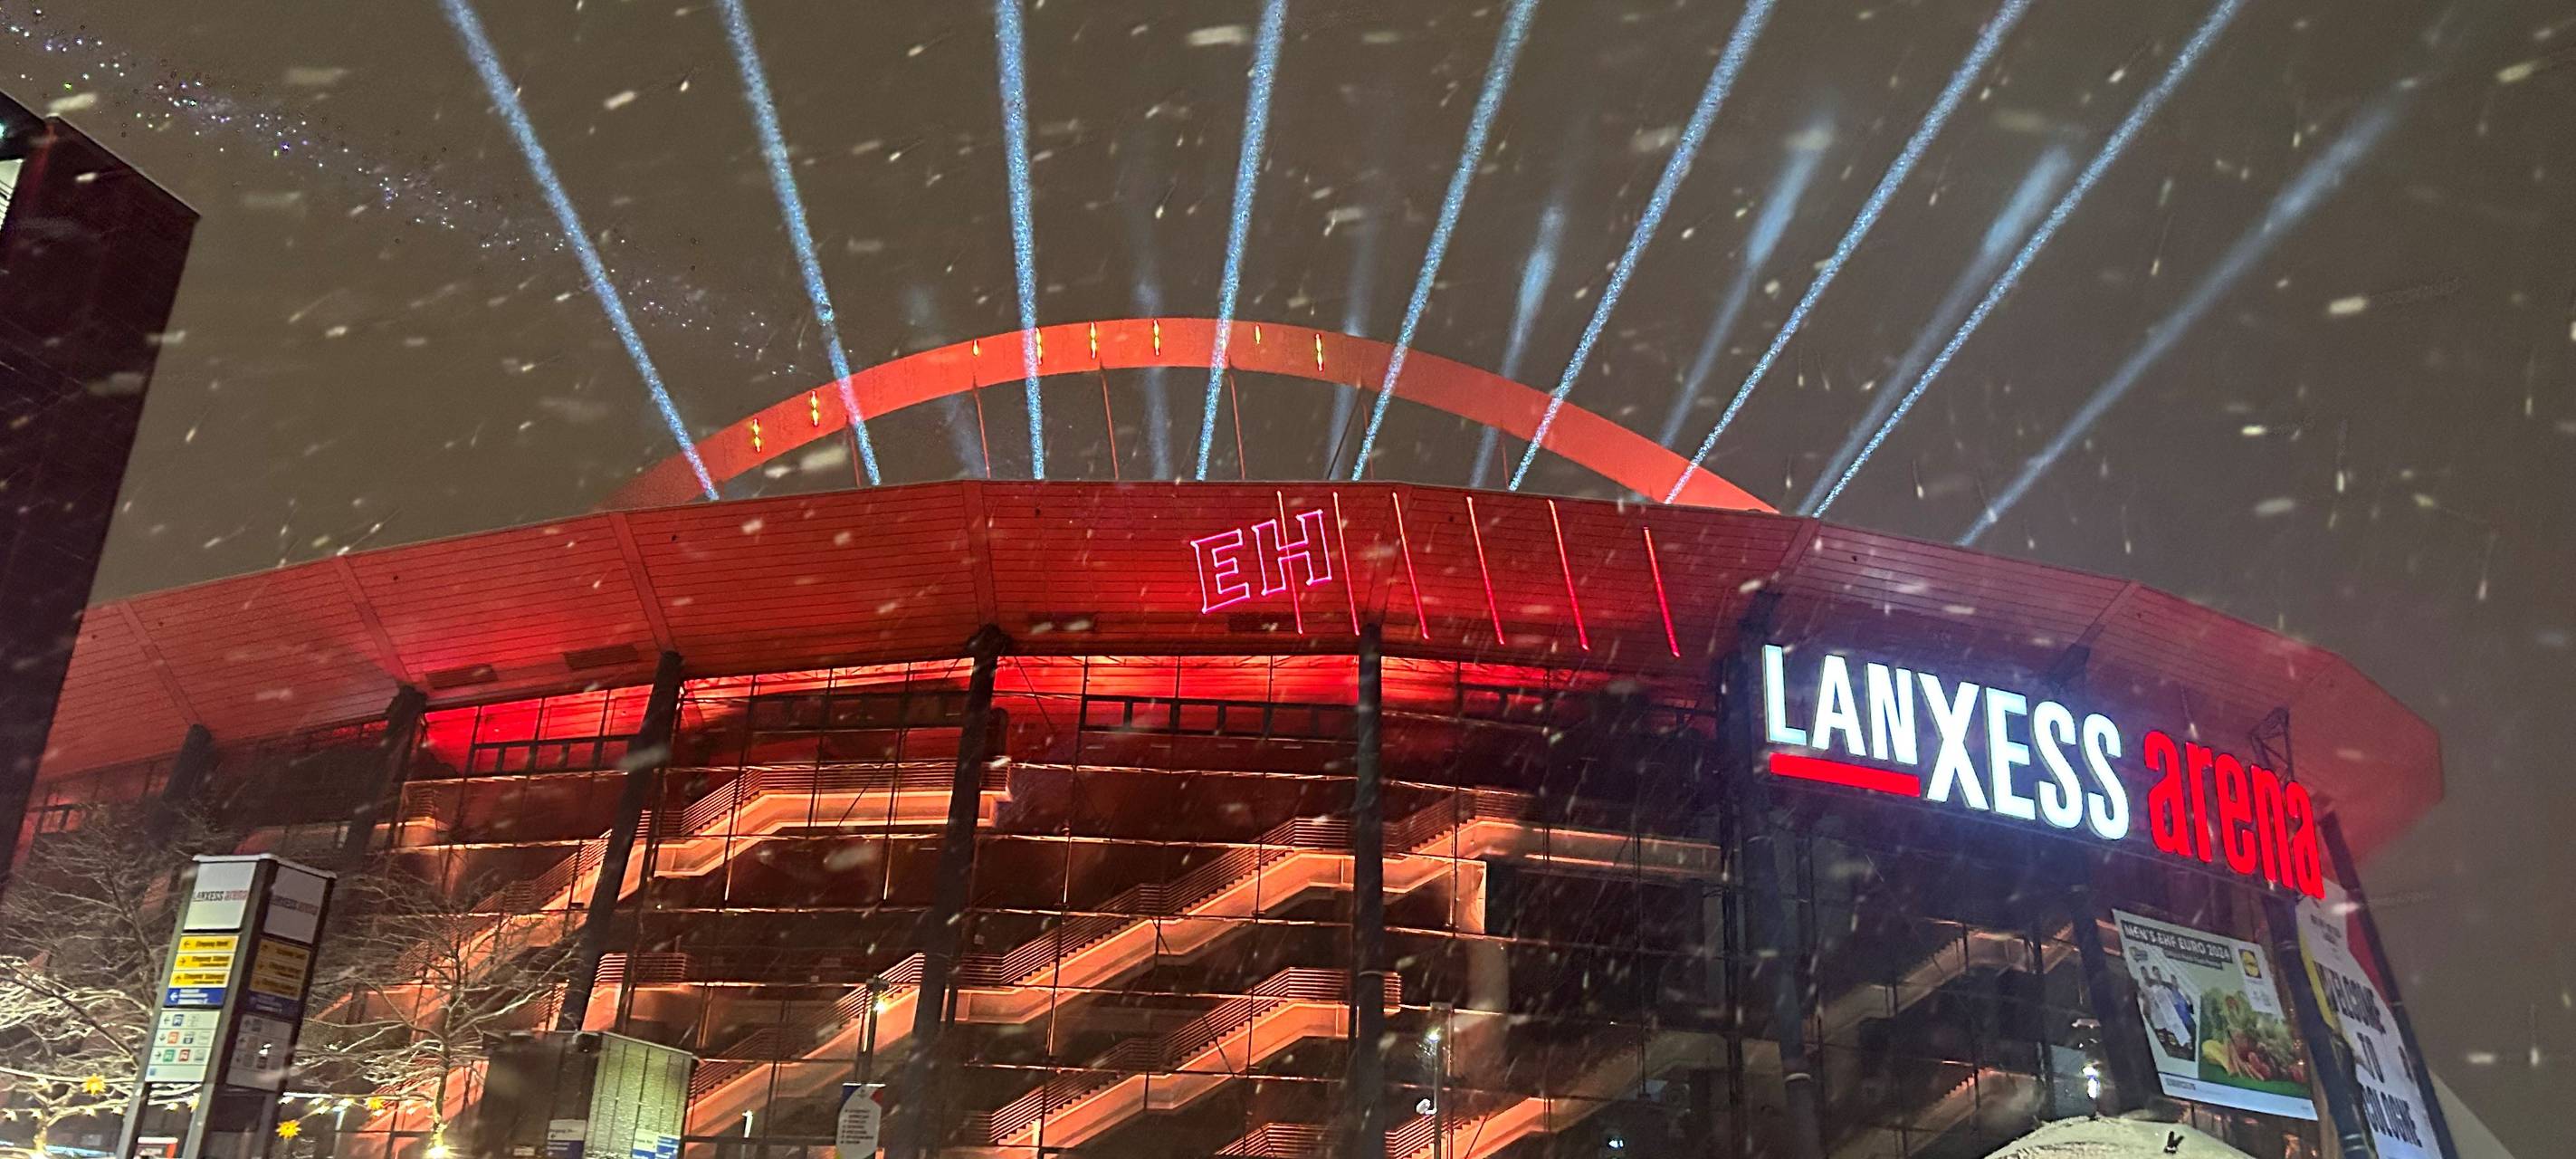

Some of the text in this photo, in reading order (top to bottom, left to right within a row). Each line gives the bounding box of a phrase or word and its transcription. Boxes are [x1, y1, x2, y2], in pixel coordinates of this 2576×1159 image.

[1762, 644, 2326, 899] LANXESS arena
[2123, 924, 2156, 943] MEN'S
[2157, 931, 2176, 949] EHF
[2178, 936, 2206, 954] EURO
[2206, 943, 2231, 960] 2024
